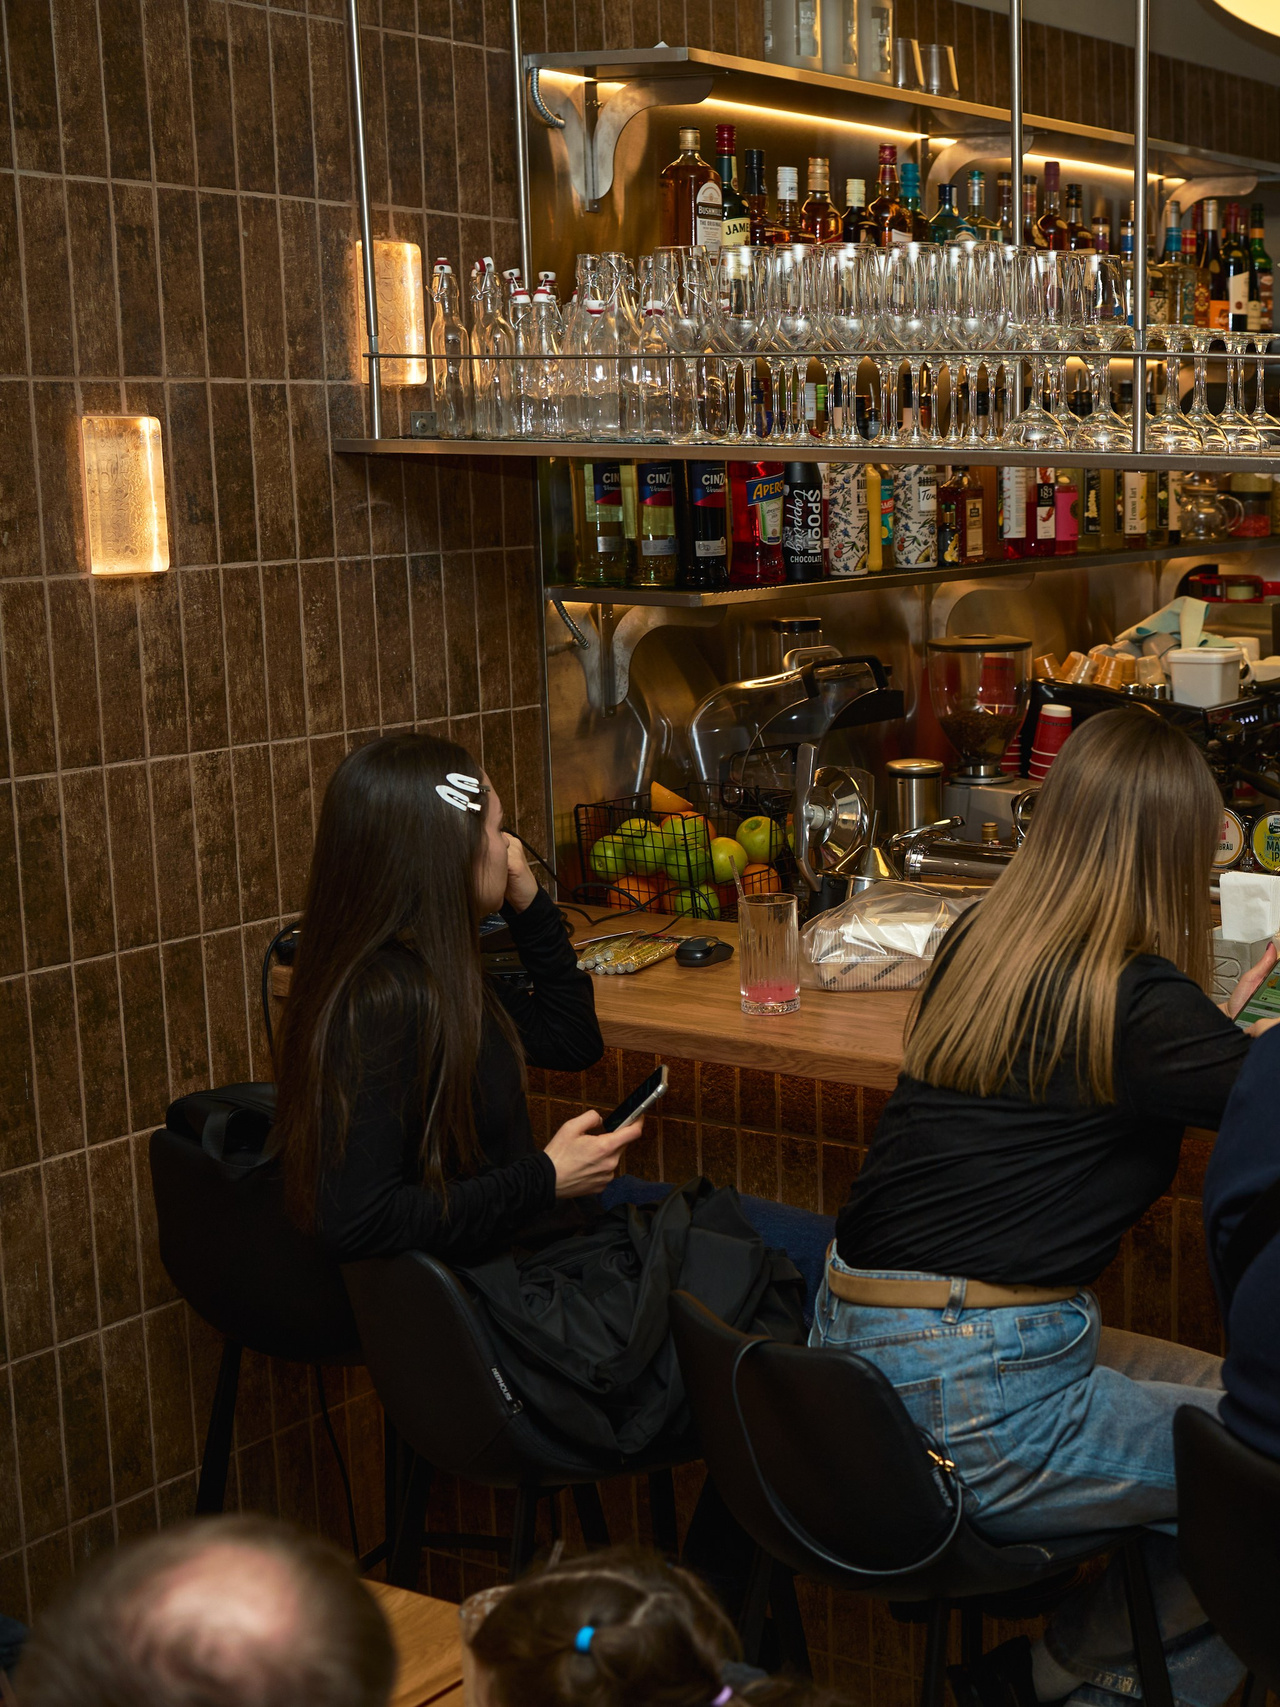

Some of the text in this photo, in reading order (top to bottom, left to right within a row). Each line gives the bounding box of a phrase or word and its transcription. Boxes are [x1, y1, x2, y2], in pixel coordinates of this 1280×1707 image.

[786, 489, 810, 555] topping
[807, 489, 821, 554] SPOOM
[1217, 841, 1234, 851] BRÄU
